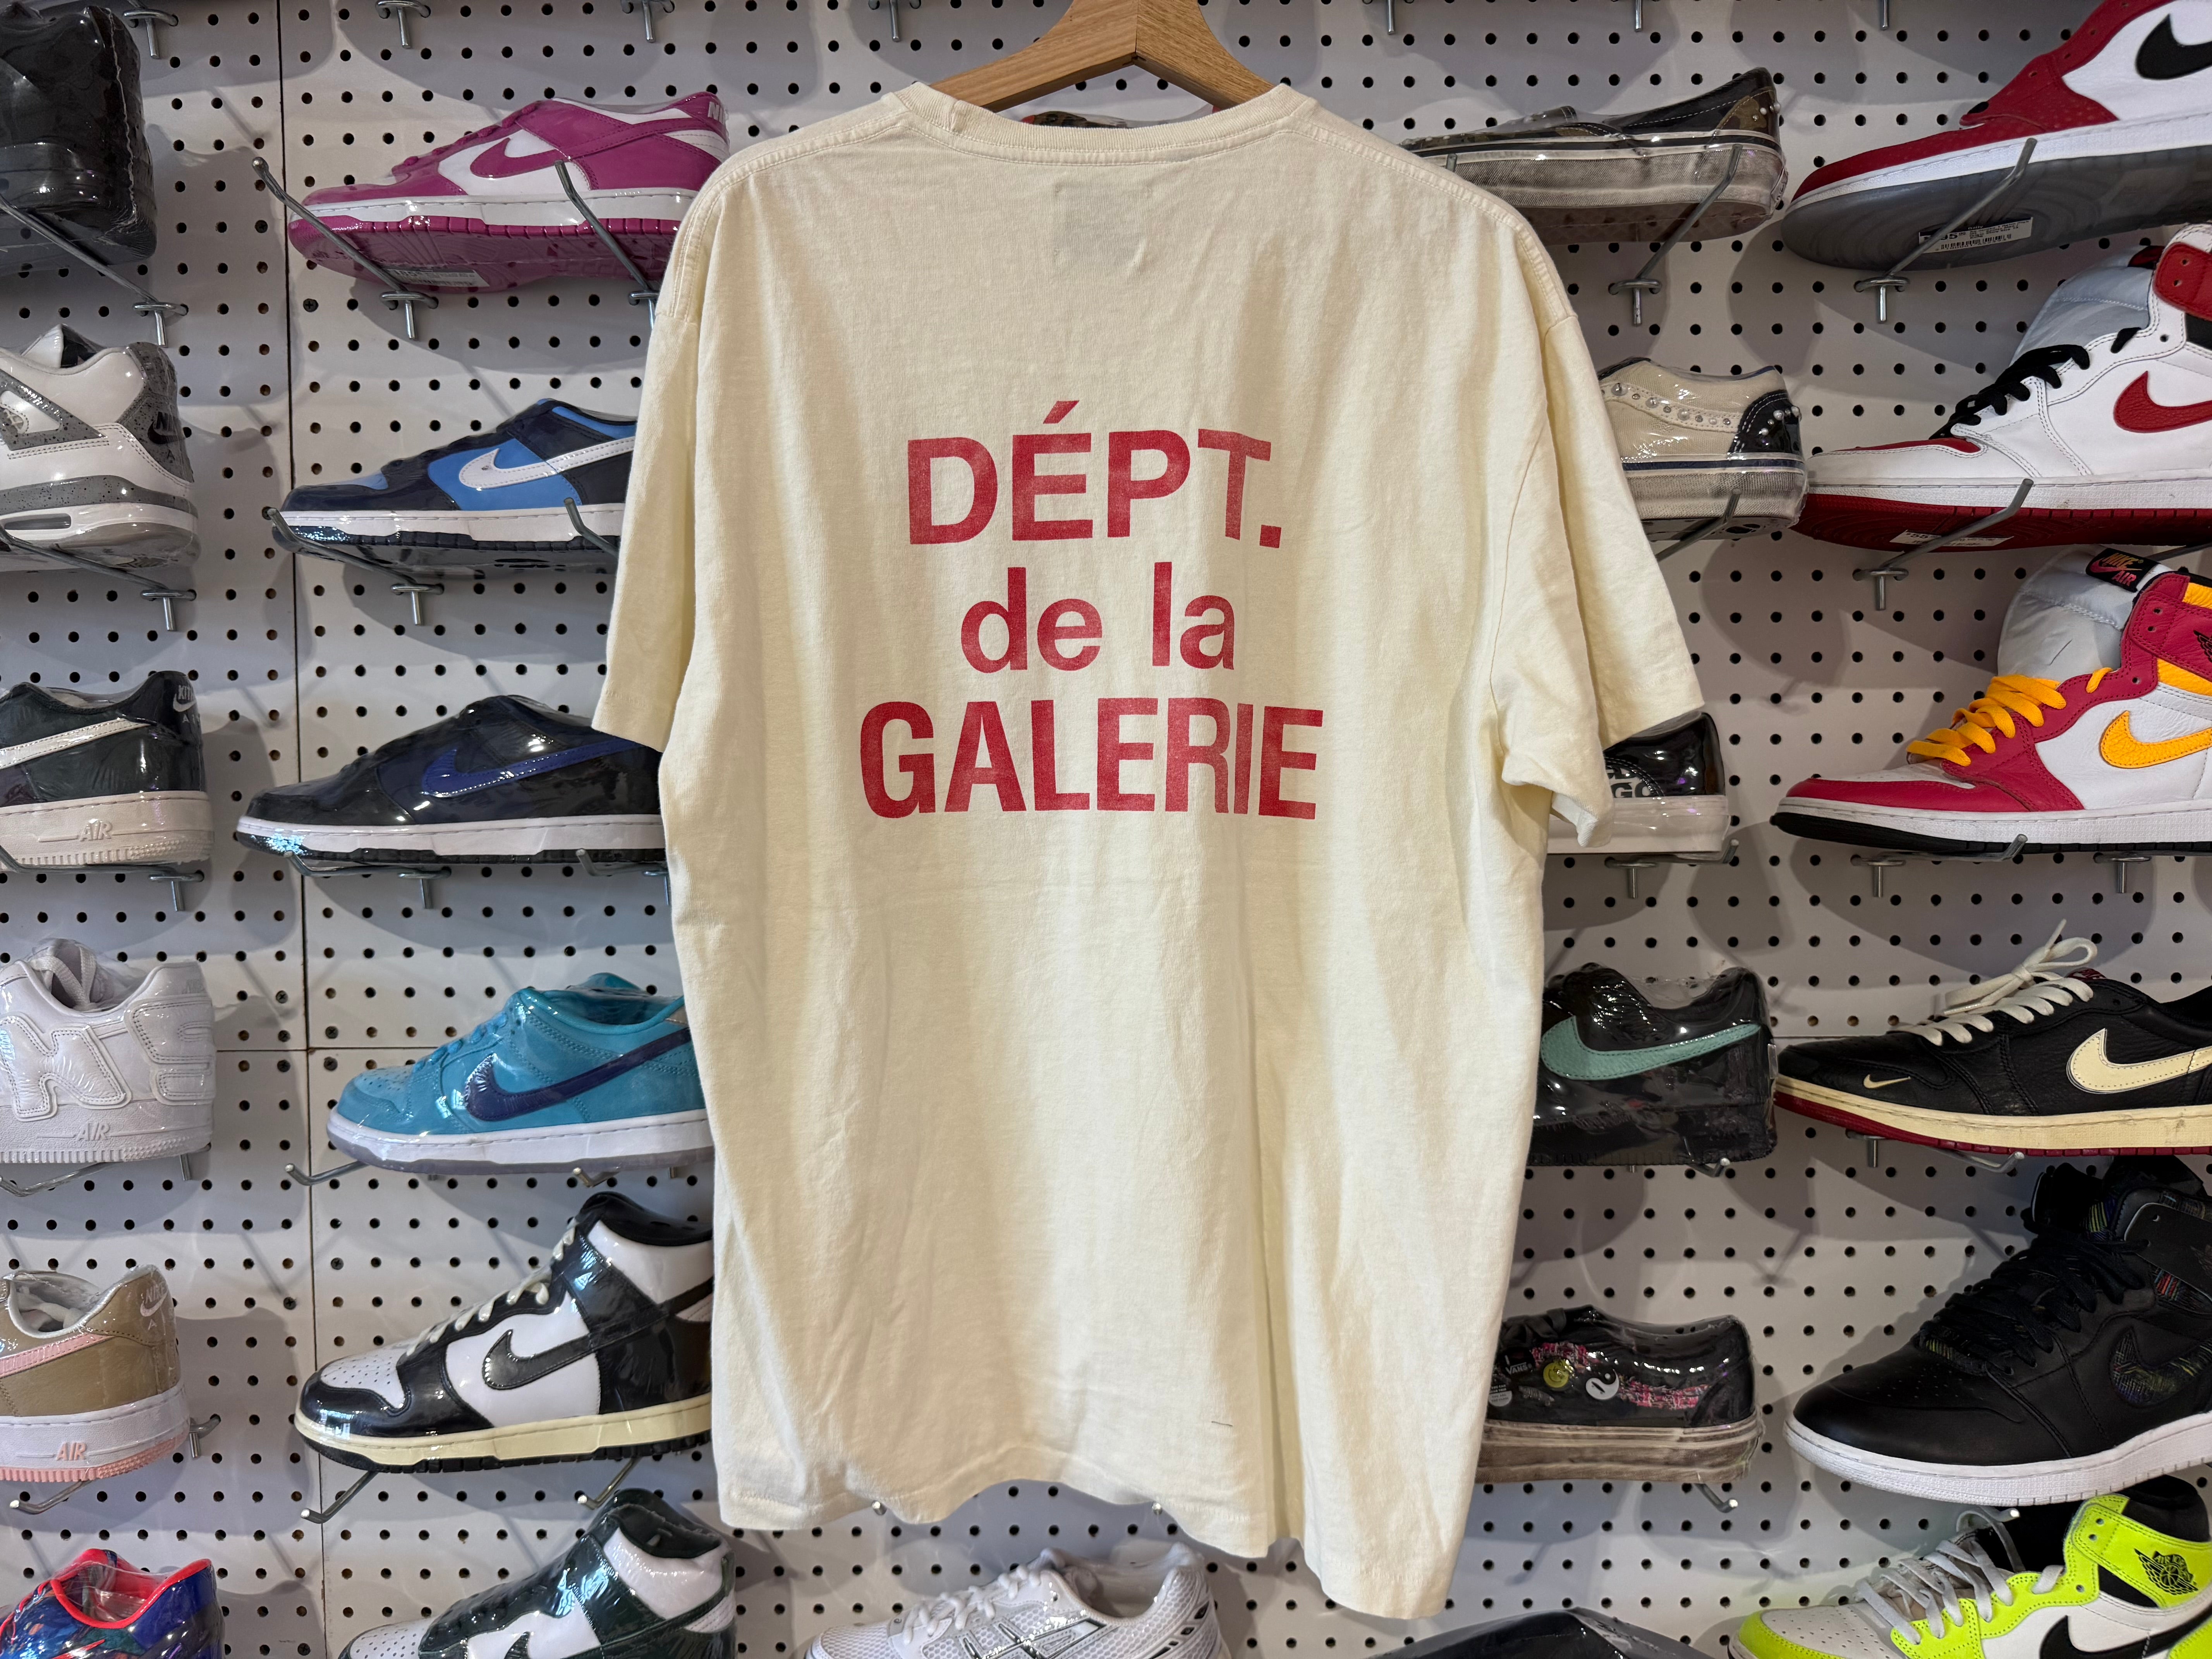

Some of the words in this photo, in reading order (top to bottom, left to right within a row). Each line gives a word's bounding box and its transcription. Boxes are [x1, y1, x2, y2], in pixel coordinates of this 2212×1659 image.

[907, 400, 1282, 549] DÉPT.
[2102, 552, 2139, 570] NIKE
[2112, 570, 2137, 587] AIR
[960, 567, 1103, 674] de
[1152, 562, 1235, 670] la
[860, 697, 1323, 820] GALERIE
[79, 819, 112, 842] AIR
[77, 1121, 110, 1141] AIR
[1505, 1362, 1528, 1375] VANS
[55, 1441, 88, 1461] AIR
